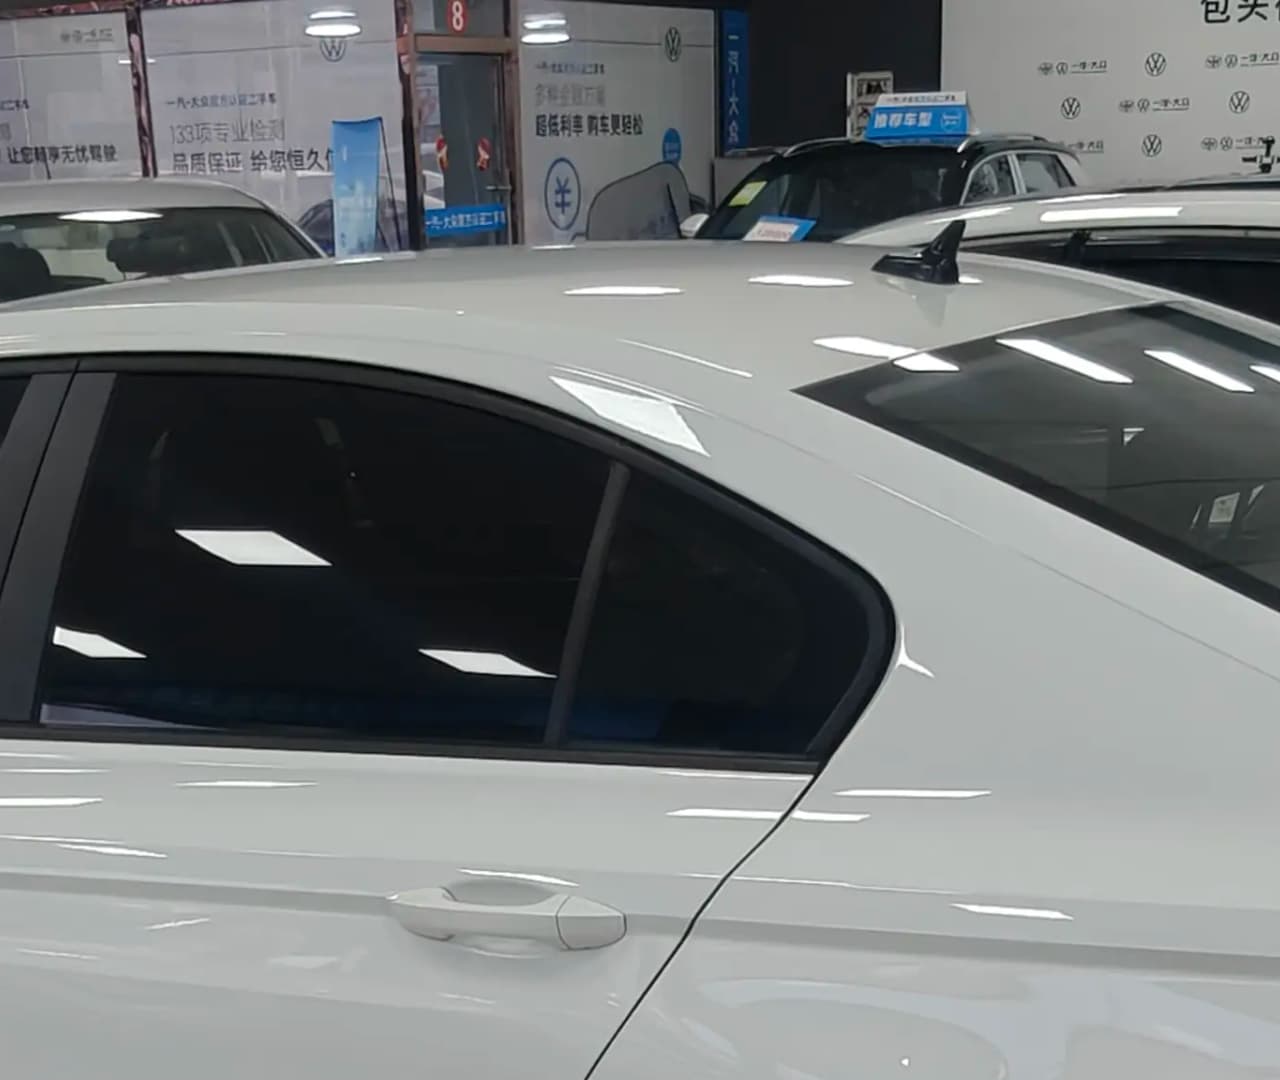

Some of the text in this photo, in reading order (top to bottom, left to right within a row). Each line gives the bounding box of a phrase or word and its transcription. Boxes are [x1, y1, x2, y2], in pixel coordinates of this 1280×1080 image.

[452, 1, 464, 31] 8
[172, 152, 242, 174] 品质保证
